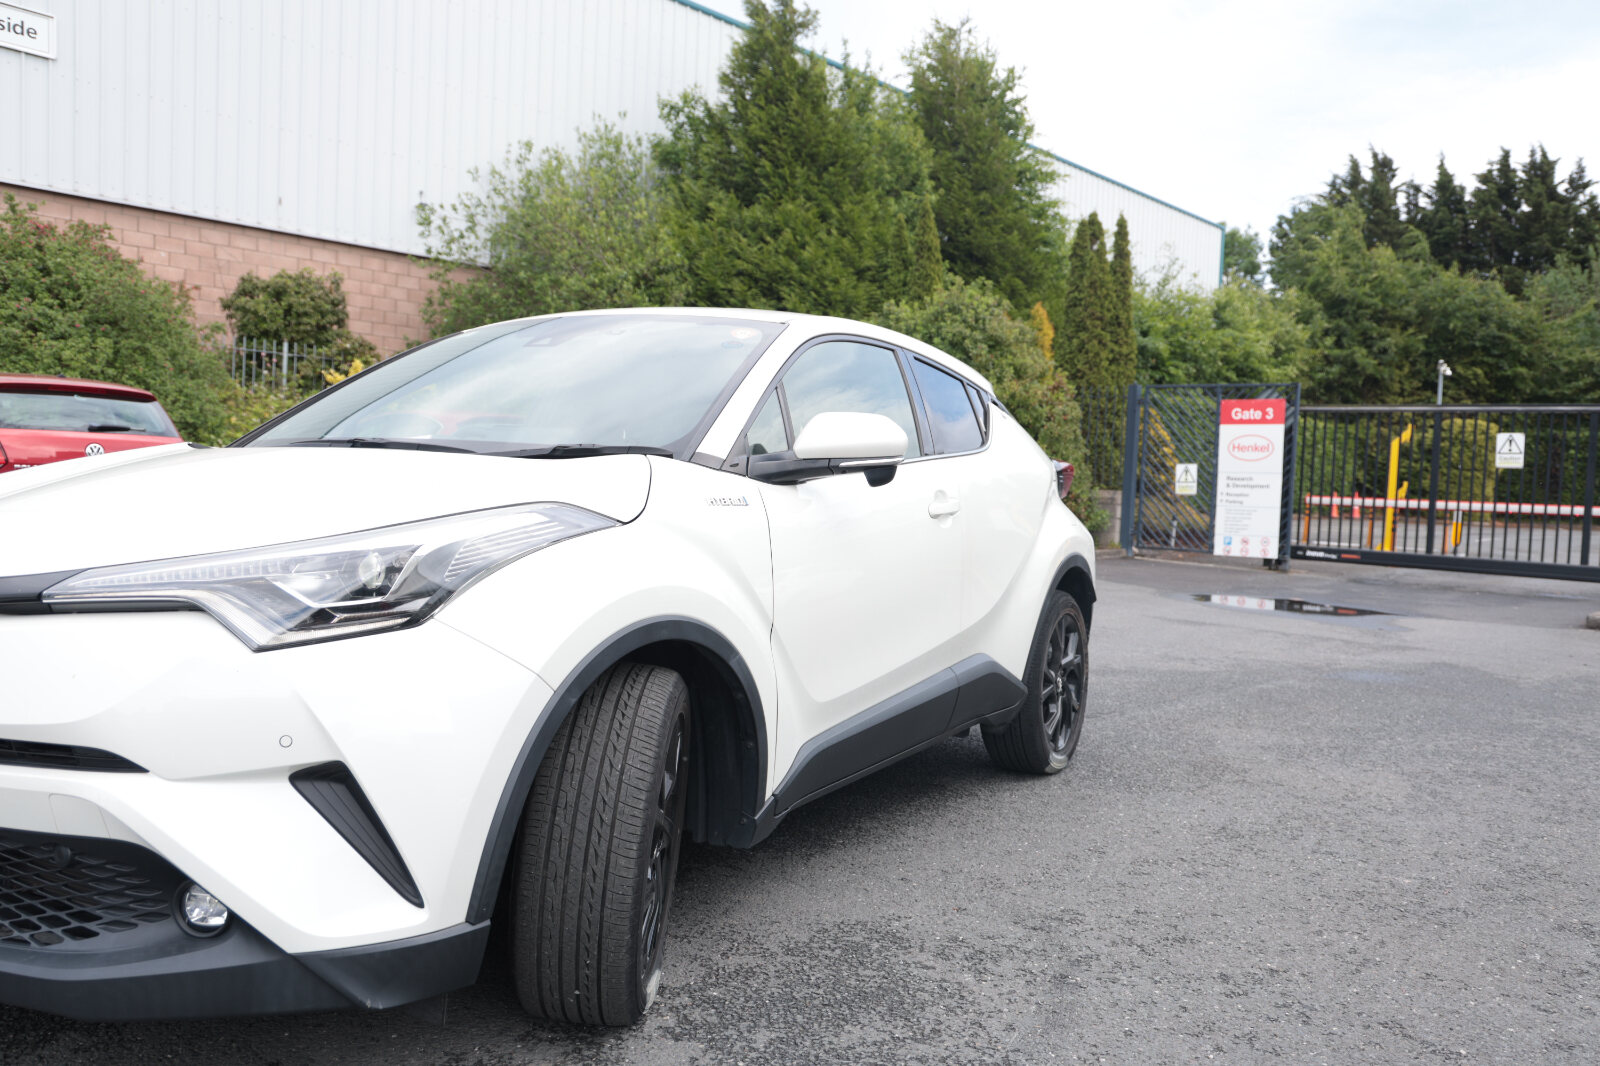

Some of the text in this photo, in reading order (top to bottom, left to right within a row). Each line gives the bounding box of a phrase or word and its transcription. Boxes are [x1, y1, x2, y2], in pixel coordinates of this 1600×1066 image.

[1231, 407, 1275, 421] Gate 3
[1231, 443, 1271, 454] Henkel
